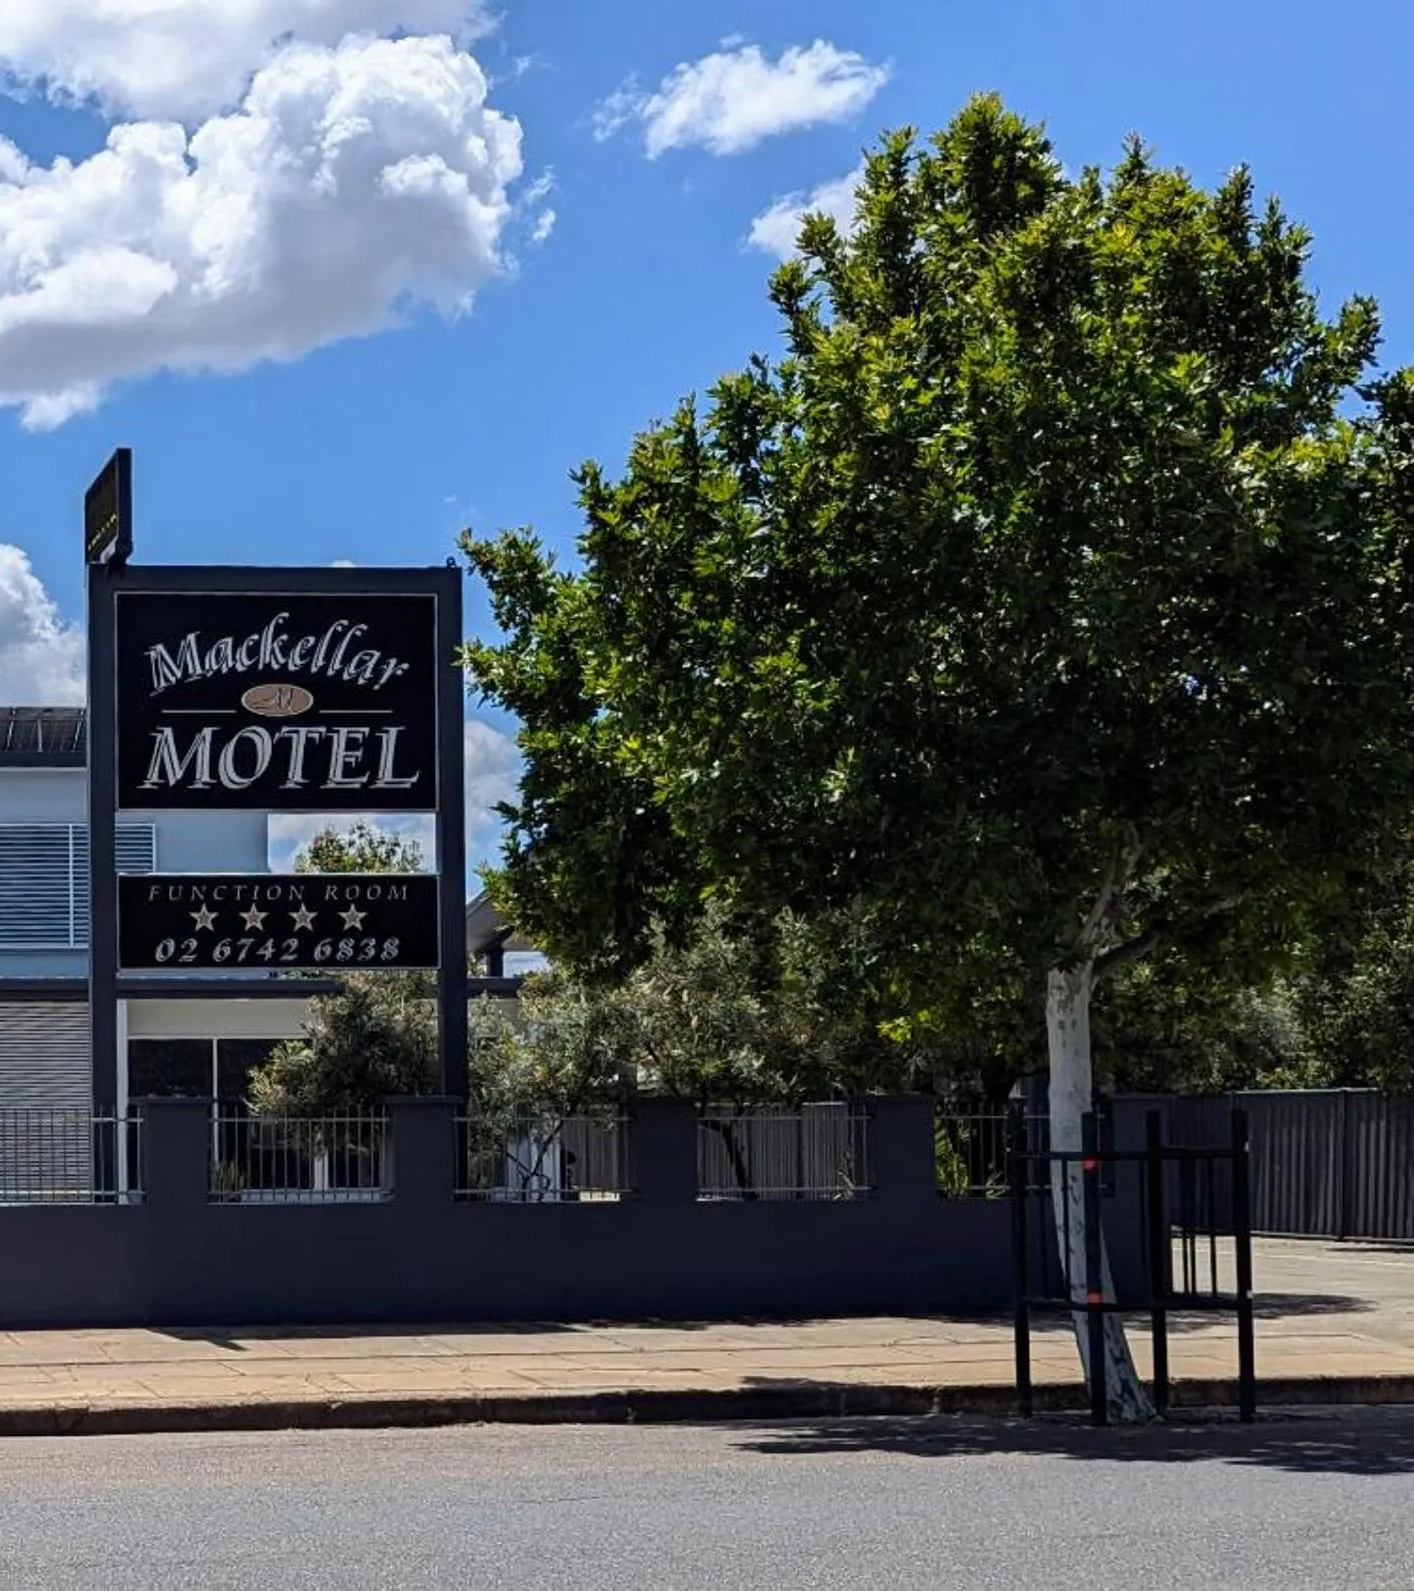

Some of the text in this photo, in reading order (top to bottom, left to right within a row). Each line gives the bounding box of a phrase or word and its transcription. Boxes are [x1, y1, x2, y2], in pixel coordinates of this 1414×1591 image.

[144, 612, 409, 696] Mackellar
[136, 725, 421, 790] MOTEL
[148, 884, 409, 901] FUNCTION ROOM
[154, 937, 401, 962] 02 6742 6838
